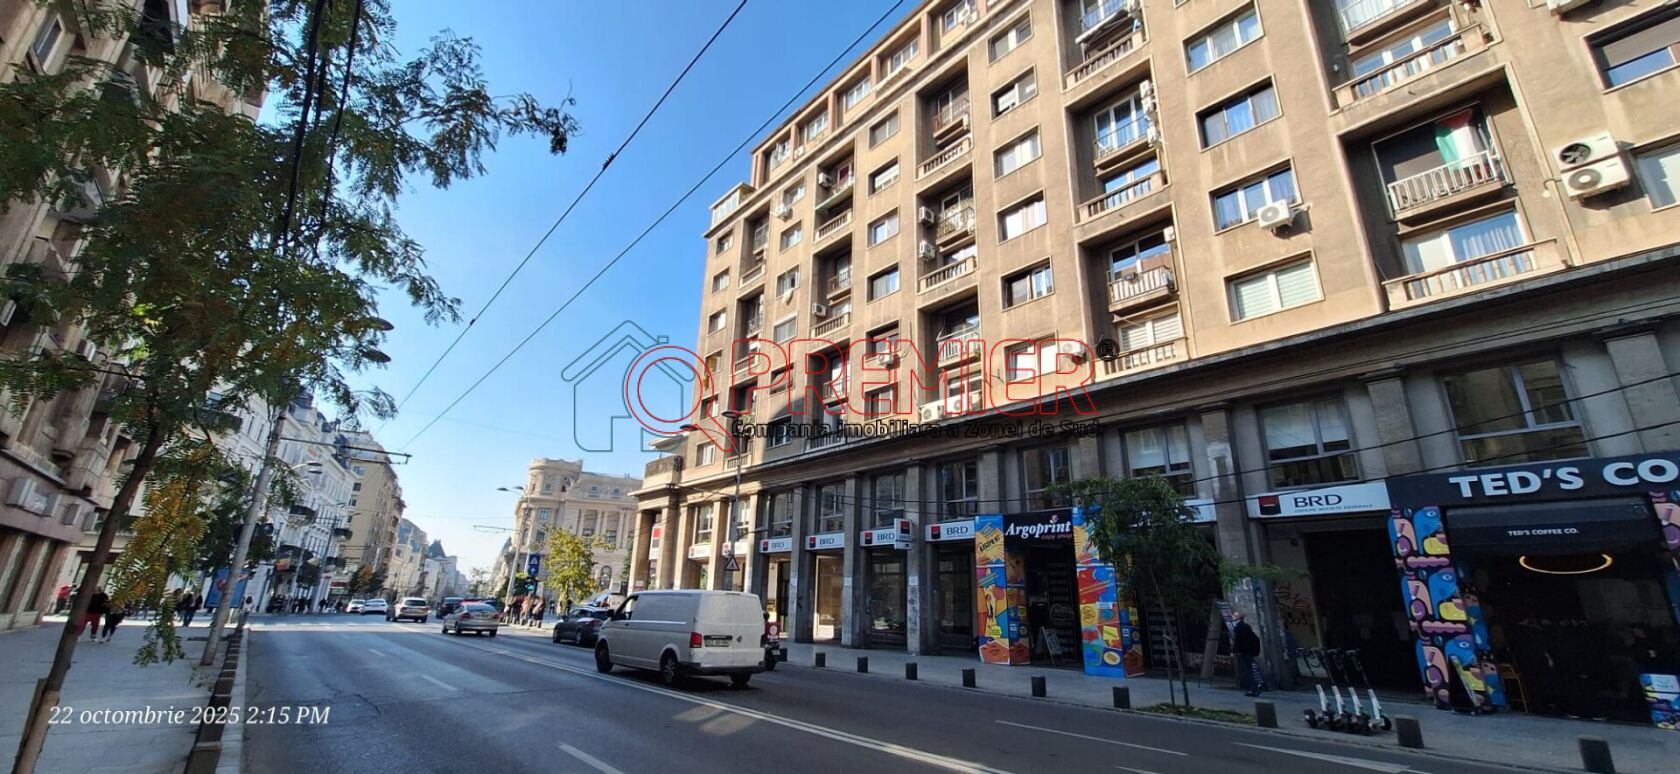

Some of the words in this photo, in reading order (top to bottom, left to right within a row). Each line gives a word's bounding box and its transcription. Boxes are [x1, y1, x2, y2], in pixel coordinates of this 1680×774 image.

[1448, 466, 1584, 498] TED'S
[1293, 494, 1343, 508] BRD
[946, 525, 969, 536] BRD
[1005, 520, 1072, 539] Argoprint
[1531, 528, 1563, 536] COFFEE
[877, 532, 895, 541] BRD
